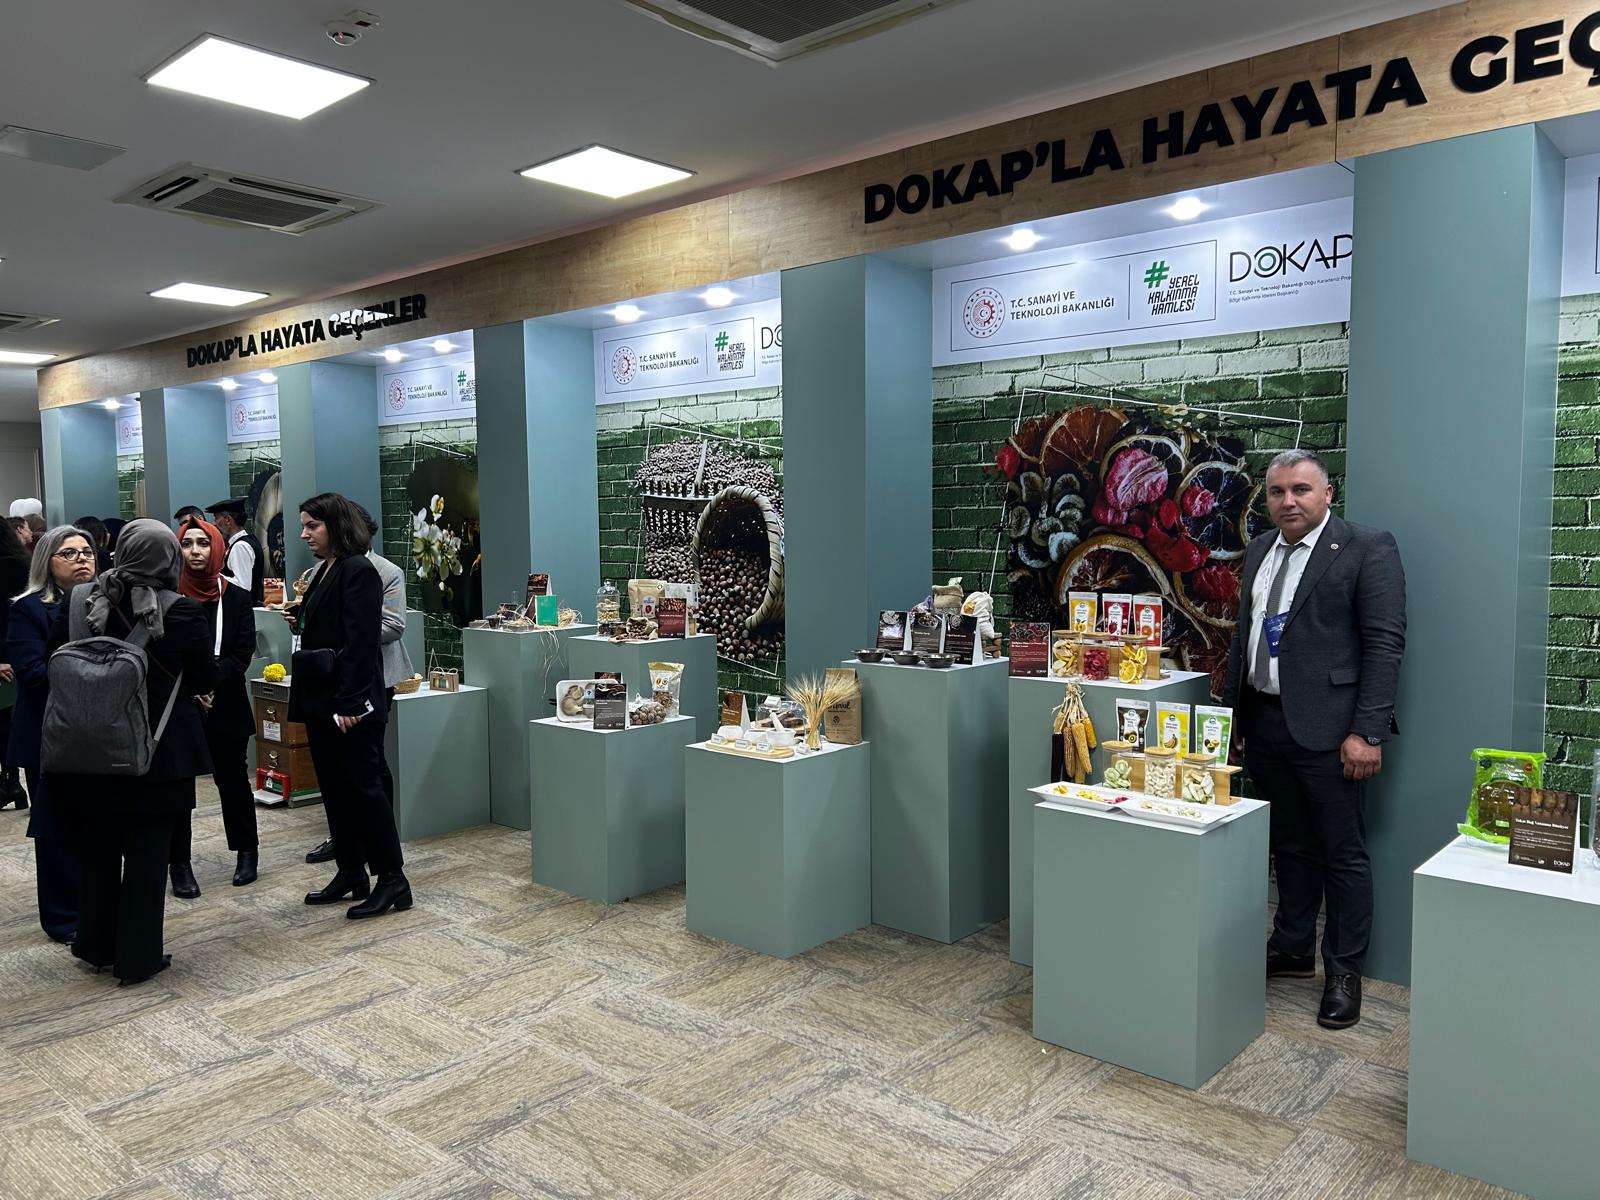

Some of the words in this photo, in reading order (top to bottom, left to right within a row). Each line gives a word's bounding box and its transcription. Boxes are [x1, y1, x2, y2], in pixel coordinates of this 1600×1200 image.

[1142, 57, 1428, 164] HAYATA
[1230, 234, 1352, 282] DOKAP
[1010, 297, 1026, 309] T.C.
[1027, 292, 1061, 307] SANAYİ
[1063, 290, 1076, 300] VE
[1148, 286, 1198, 304] KALKINMA
[1010, 304, 1060, 320] TEKNOLOJİ
[1062, 297, 1115, 314] BAKANLIĞI
[1151, 299, 1196, 316] HAMLESİ
[260, 319, 327, 353] HAYATA
[328, 293, 427, 341] GEÇENLER
[639, 360, 669, 372] TEKNOLOJİ
[649, 352, 668, 361] SANAYİ
